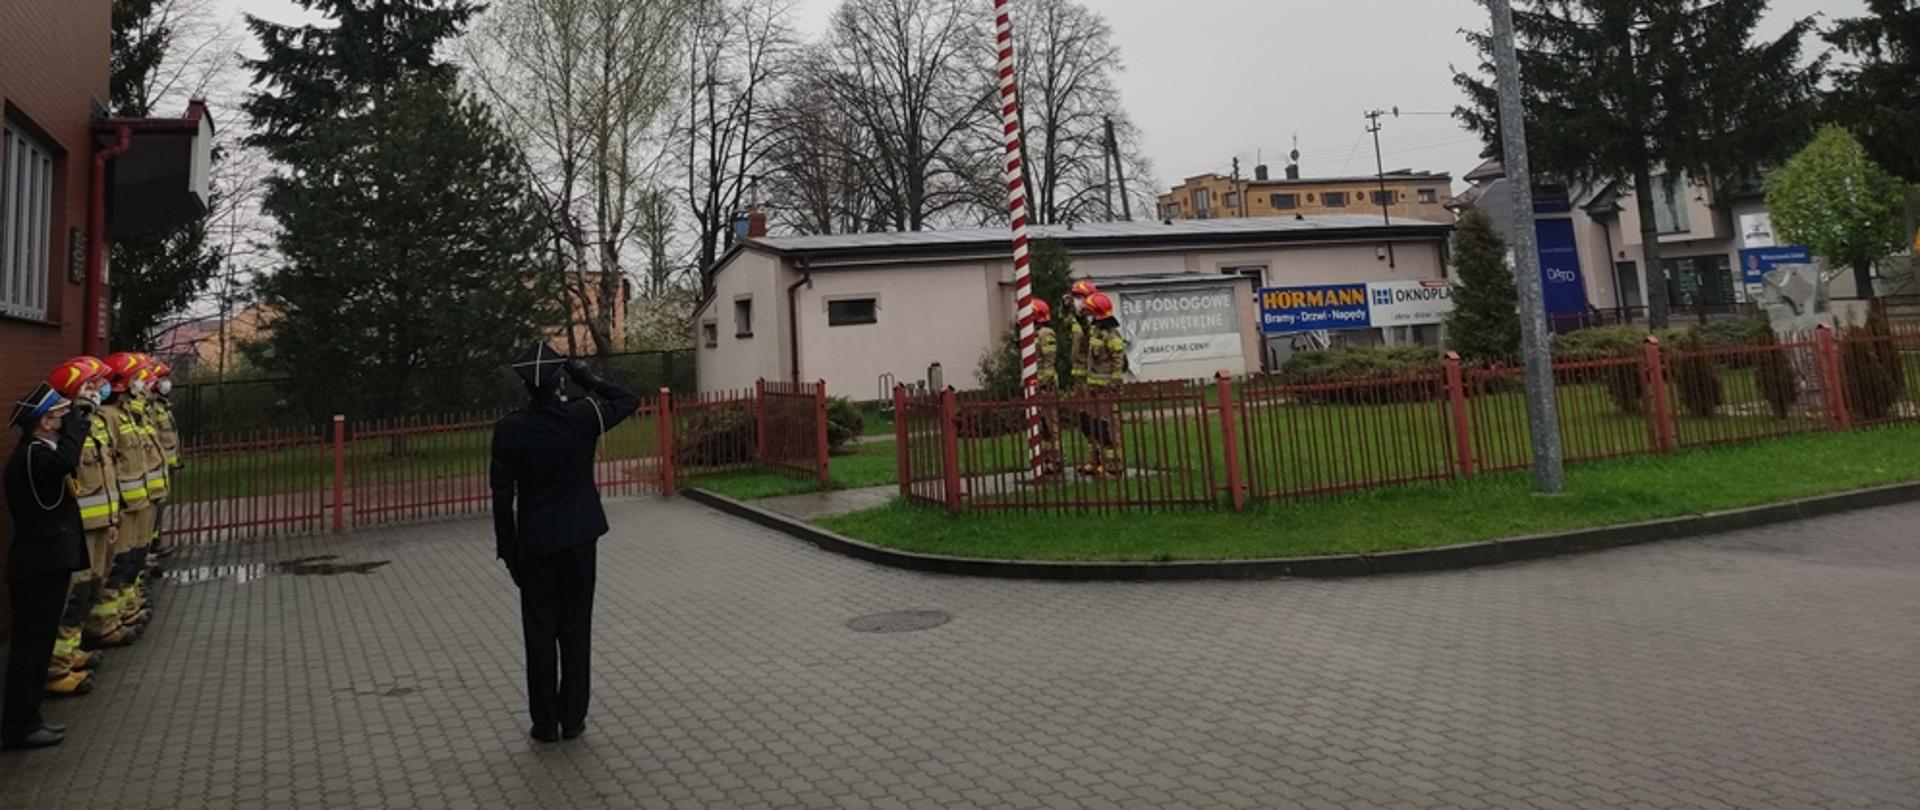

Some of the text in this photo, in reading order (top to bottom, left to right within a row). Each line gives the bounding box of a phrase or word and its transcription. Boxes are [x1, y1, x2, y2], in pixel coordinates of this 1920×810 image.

[1263, 287, 1365, 309] HÖRMANN
[1264, 313, 1295, 325] Bramy
[1301, 310, 1328, 322] Drzwi
